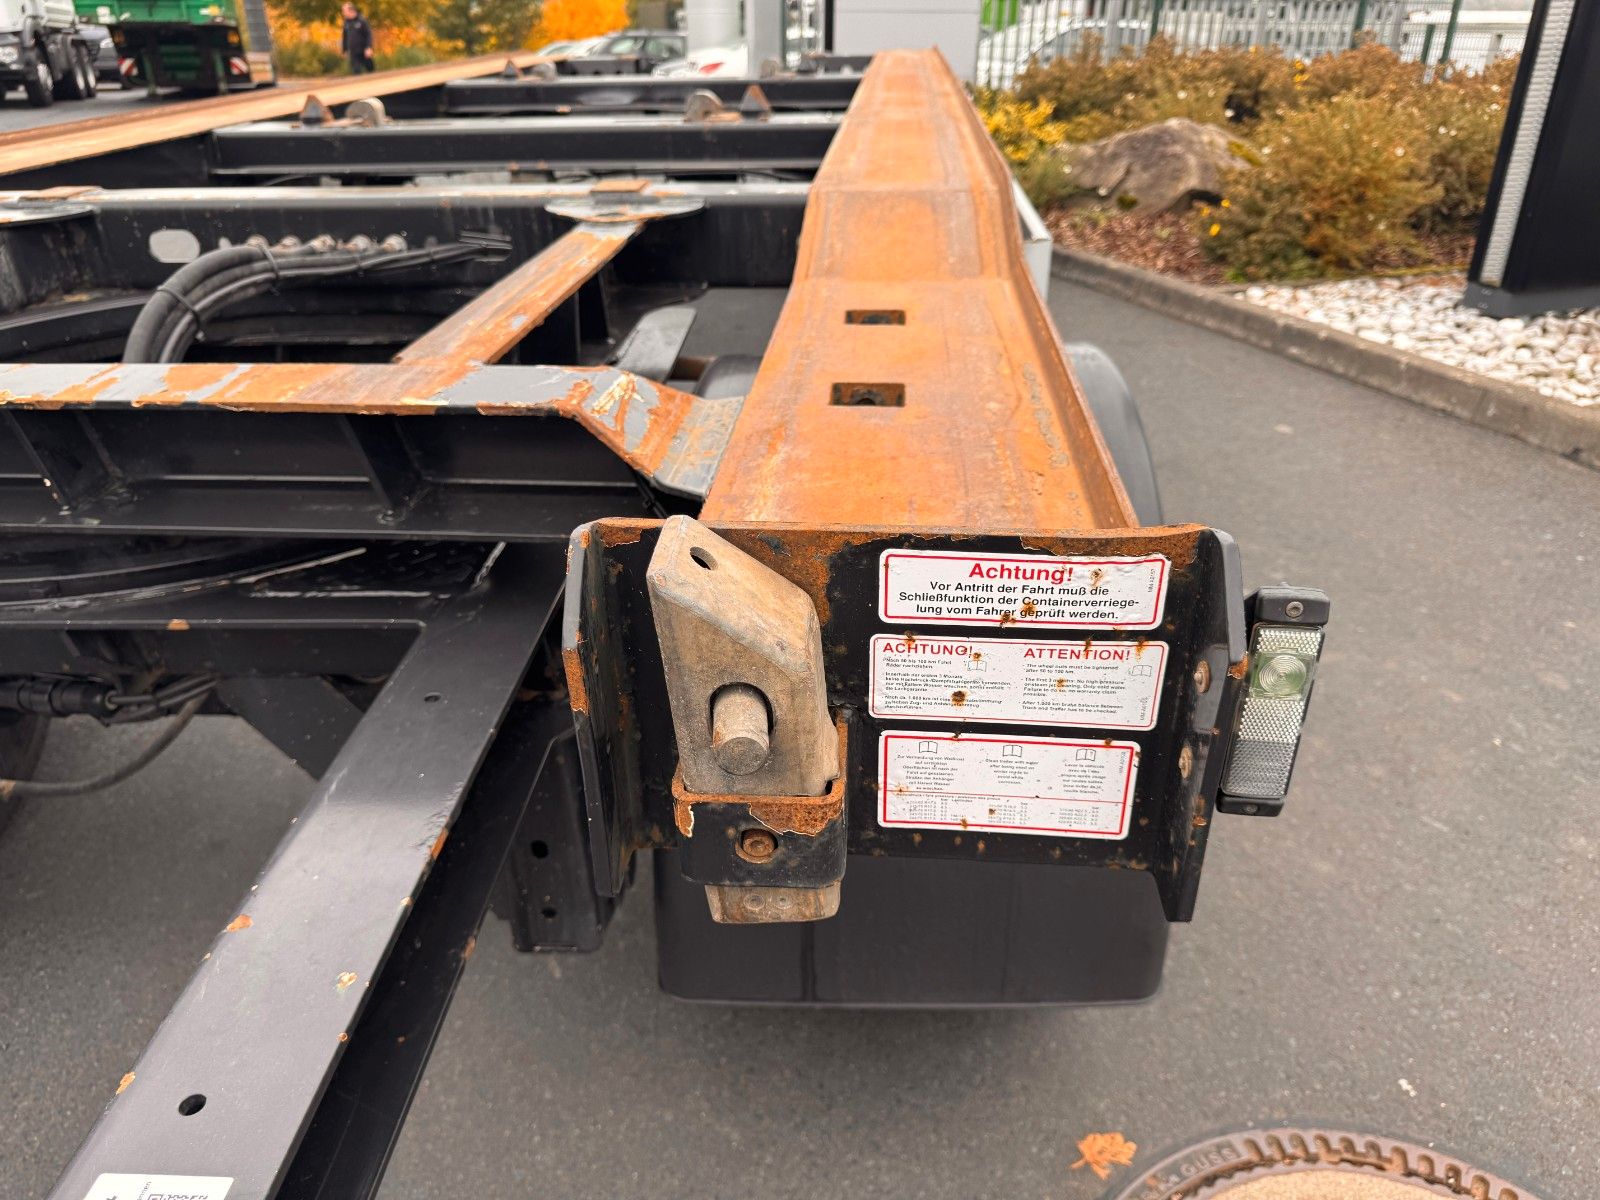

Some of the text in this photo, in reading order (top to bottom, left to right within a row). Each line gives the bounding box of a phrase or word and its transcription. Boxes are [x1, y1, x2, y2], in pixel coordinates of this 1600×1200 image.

[969, 563, 1073, 584] Achtung!
[930, 582, 1109, 596] Vor Antritt der Fahrt muß die
[899, 592, 1139, 609] Schließfunktion der Containerverriege-
[916, 604, 1119, 620] lung vom Fahrer geprüft werden.
[883, 643, 972, 658] ACHTUNG!
[1024, 648, 1130, 660] ATTENTION!
